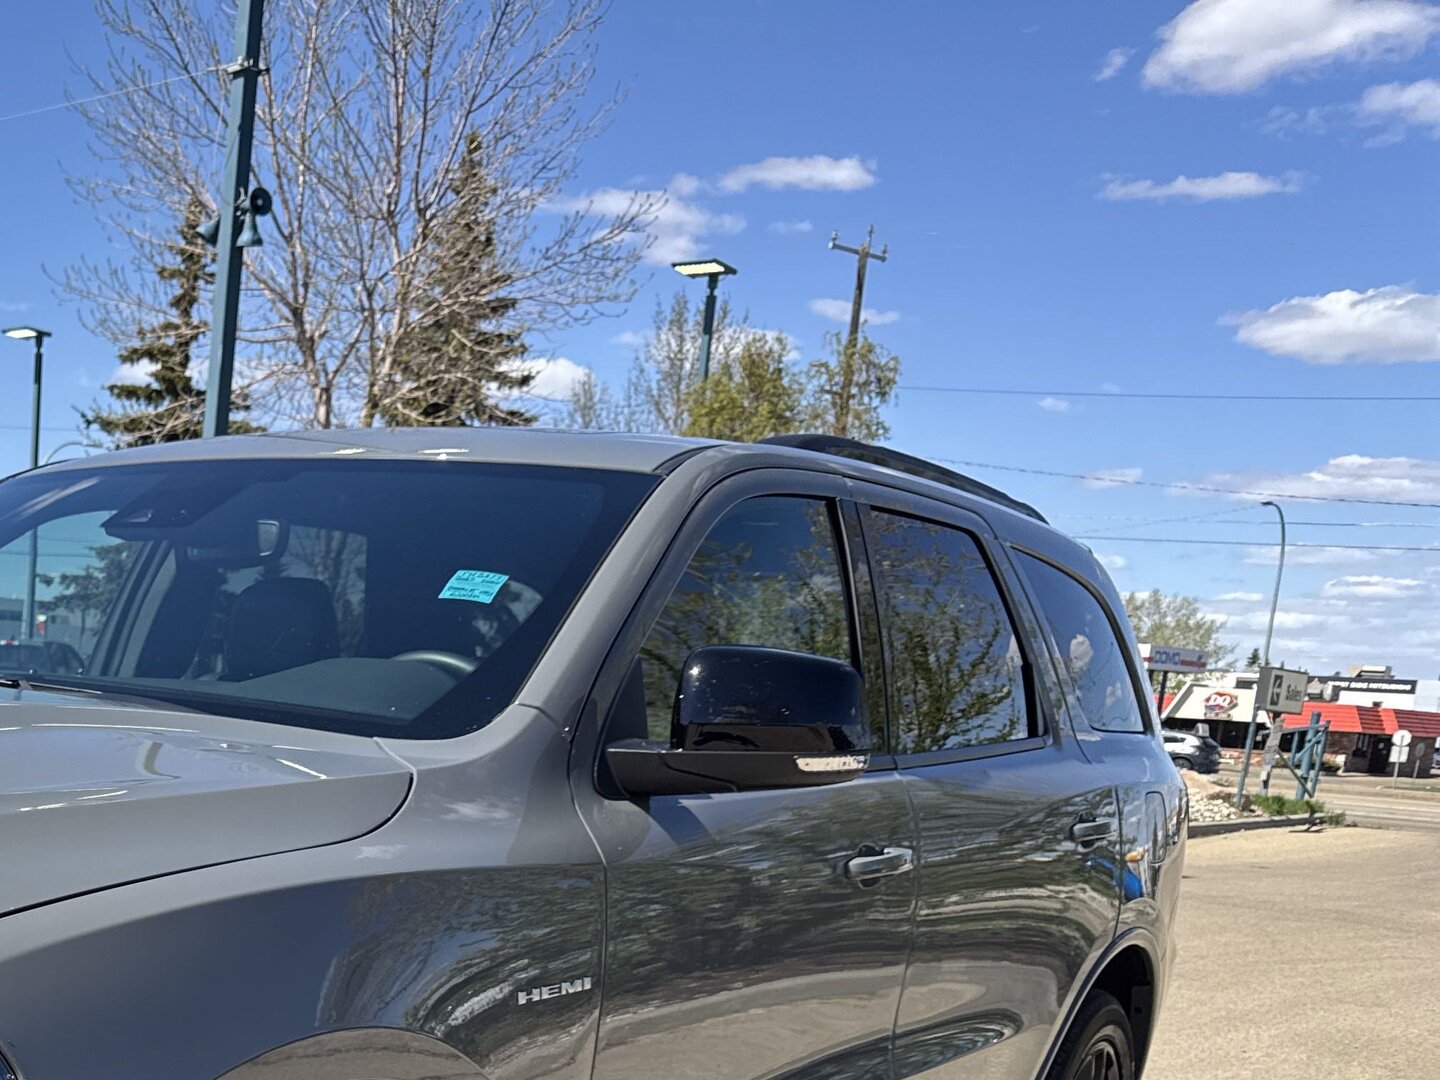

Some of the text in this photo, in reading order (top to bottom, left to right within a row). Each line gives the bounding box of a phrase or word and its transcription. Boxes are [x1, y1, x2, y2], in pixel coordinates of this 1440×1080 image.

[1154, 650, 1181, 666] DOMO
[1209, 693, 1231, 707] DQ
[517, 976, 592, 1005] HEMI
